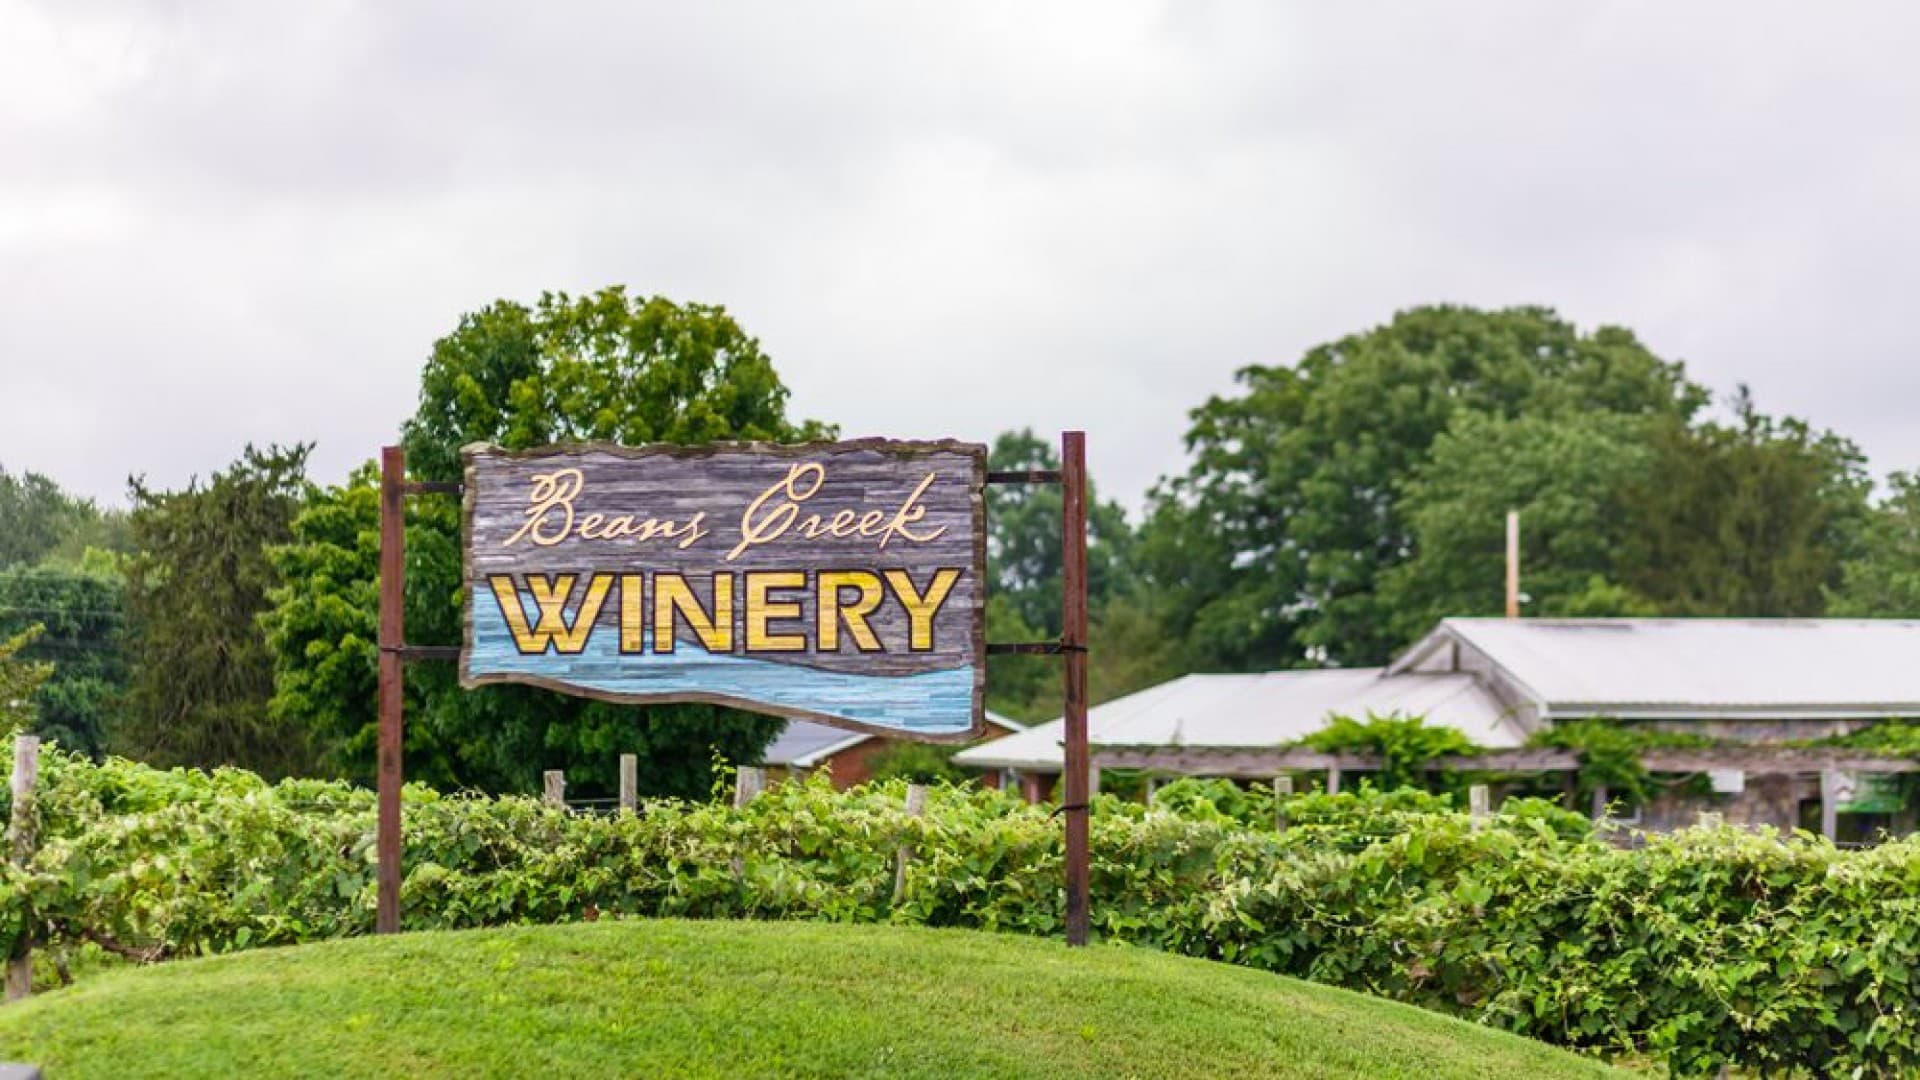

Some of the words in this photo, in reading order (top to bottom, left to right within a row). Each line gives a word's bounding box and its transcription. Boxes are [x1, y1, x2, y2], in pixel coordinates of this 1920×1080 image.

[502, 468, 710, 549] Beans
[726, 461, 948, 561] Creek
[486, 567, 966, 655] WINERY
